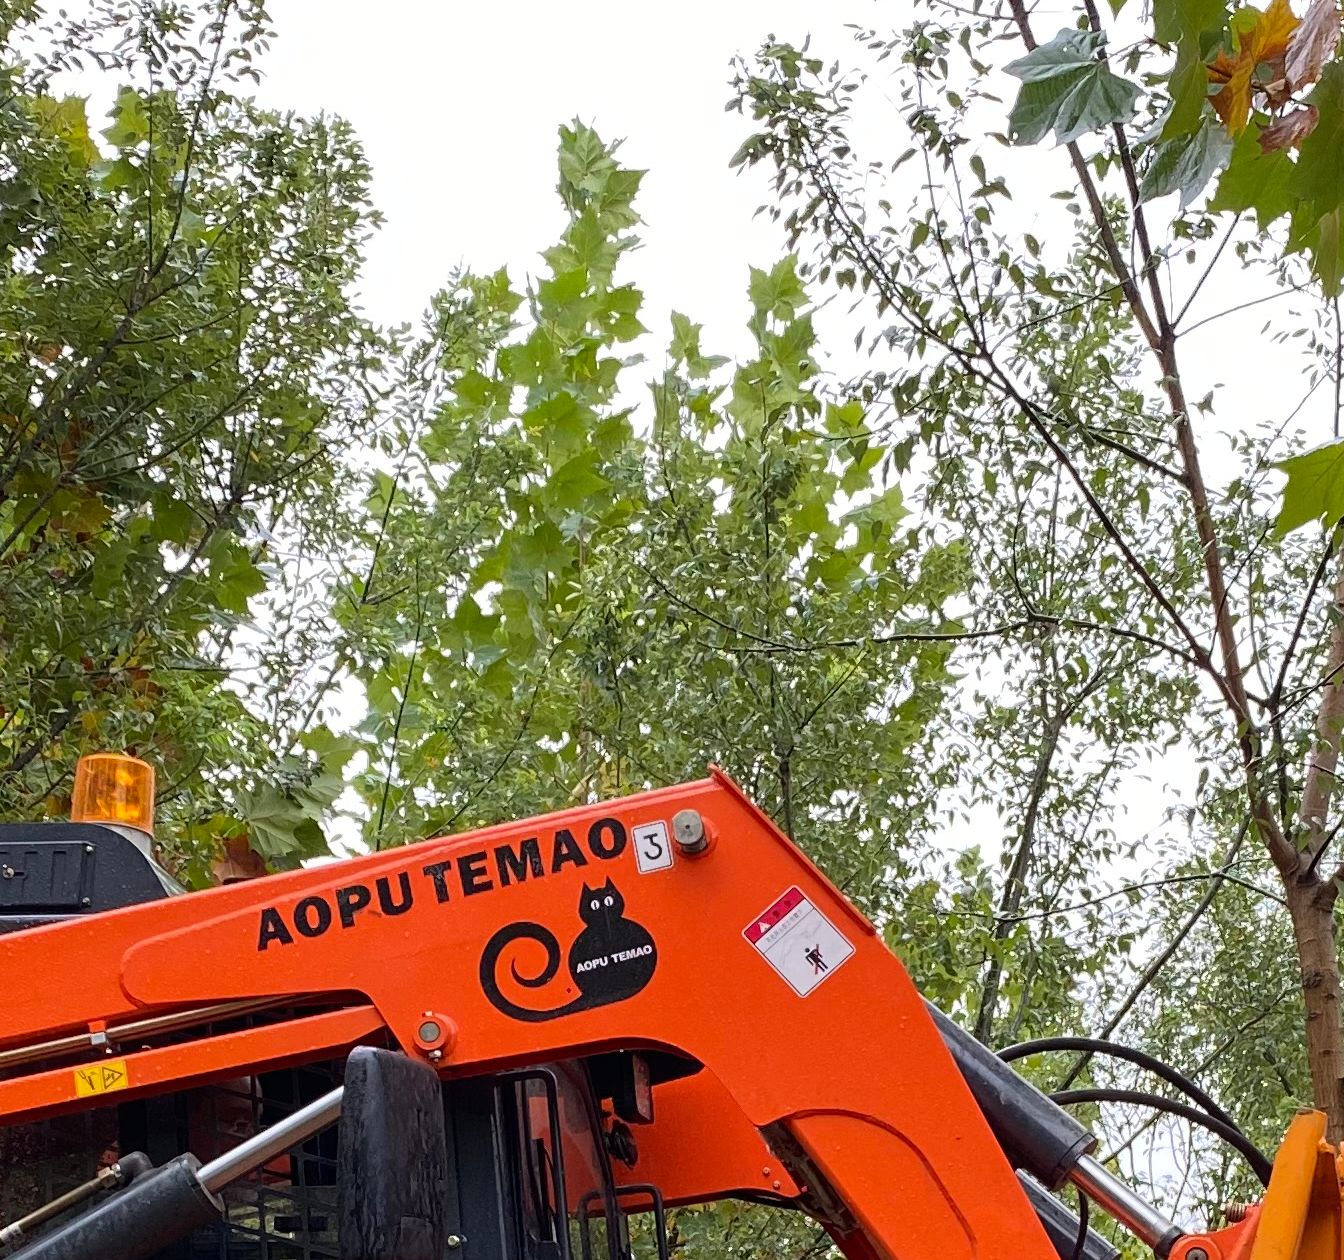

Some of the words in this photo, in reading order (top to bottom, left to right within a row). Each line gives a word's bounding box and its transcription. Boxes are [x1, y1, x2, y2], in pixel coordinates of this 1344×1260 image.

[258, 871, 413, 951] AOPU
[423, 817, 628, 903] TEMAO
[576, 956, 609, 974] AOPU
[611, 944, 653, 964] TEMAO
